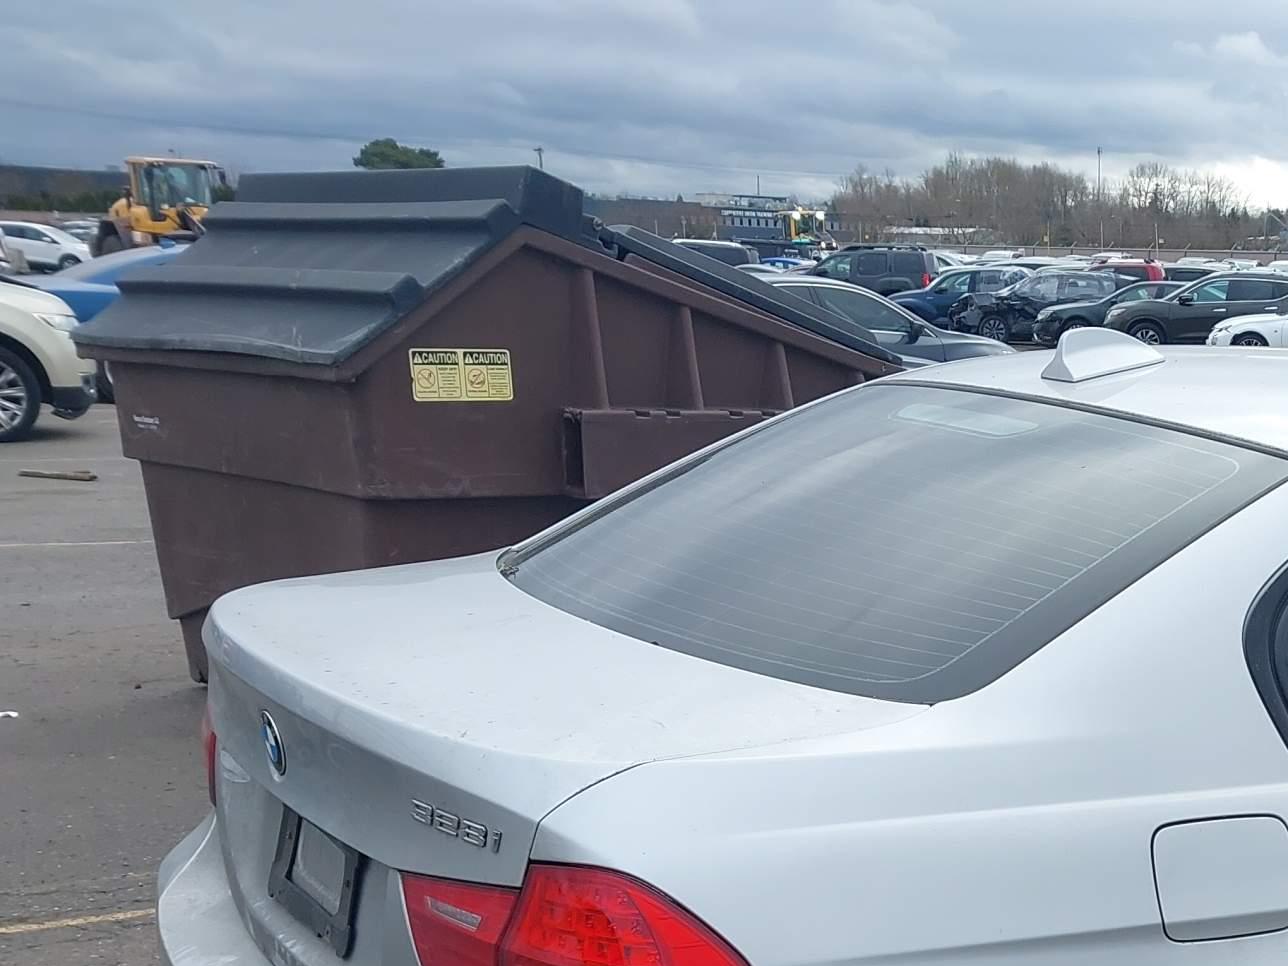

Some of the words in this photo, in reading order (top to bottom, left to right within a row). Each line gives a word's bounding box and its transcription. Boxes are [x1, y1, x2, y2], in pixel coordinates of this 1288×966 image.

[421, 352, 458, 364] CAUTION
[472, 353, 508, 364] CAUTION
[410, 798, 502, 854] 328i
